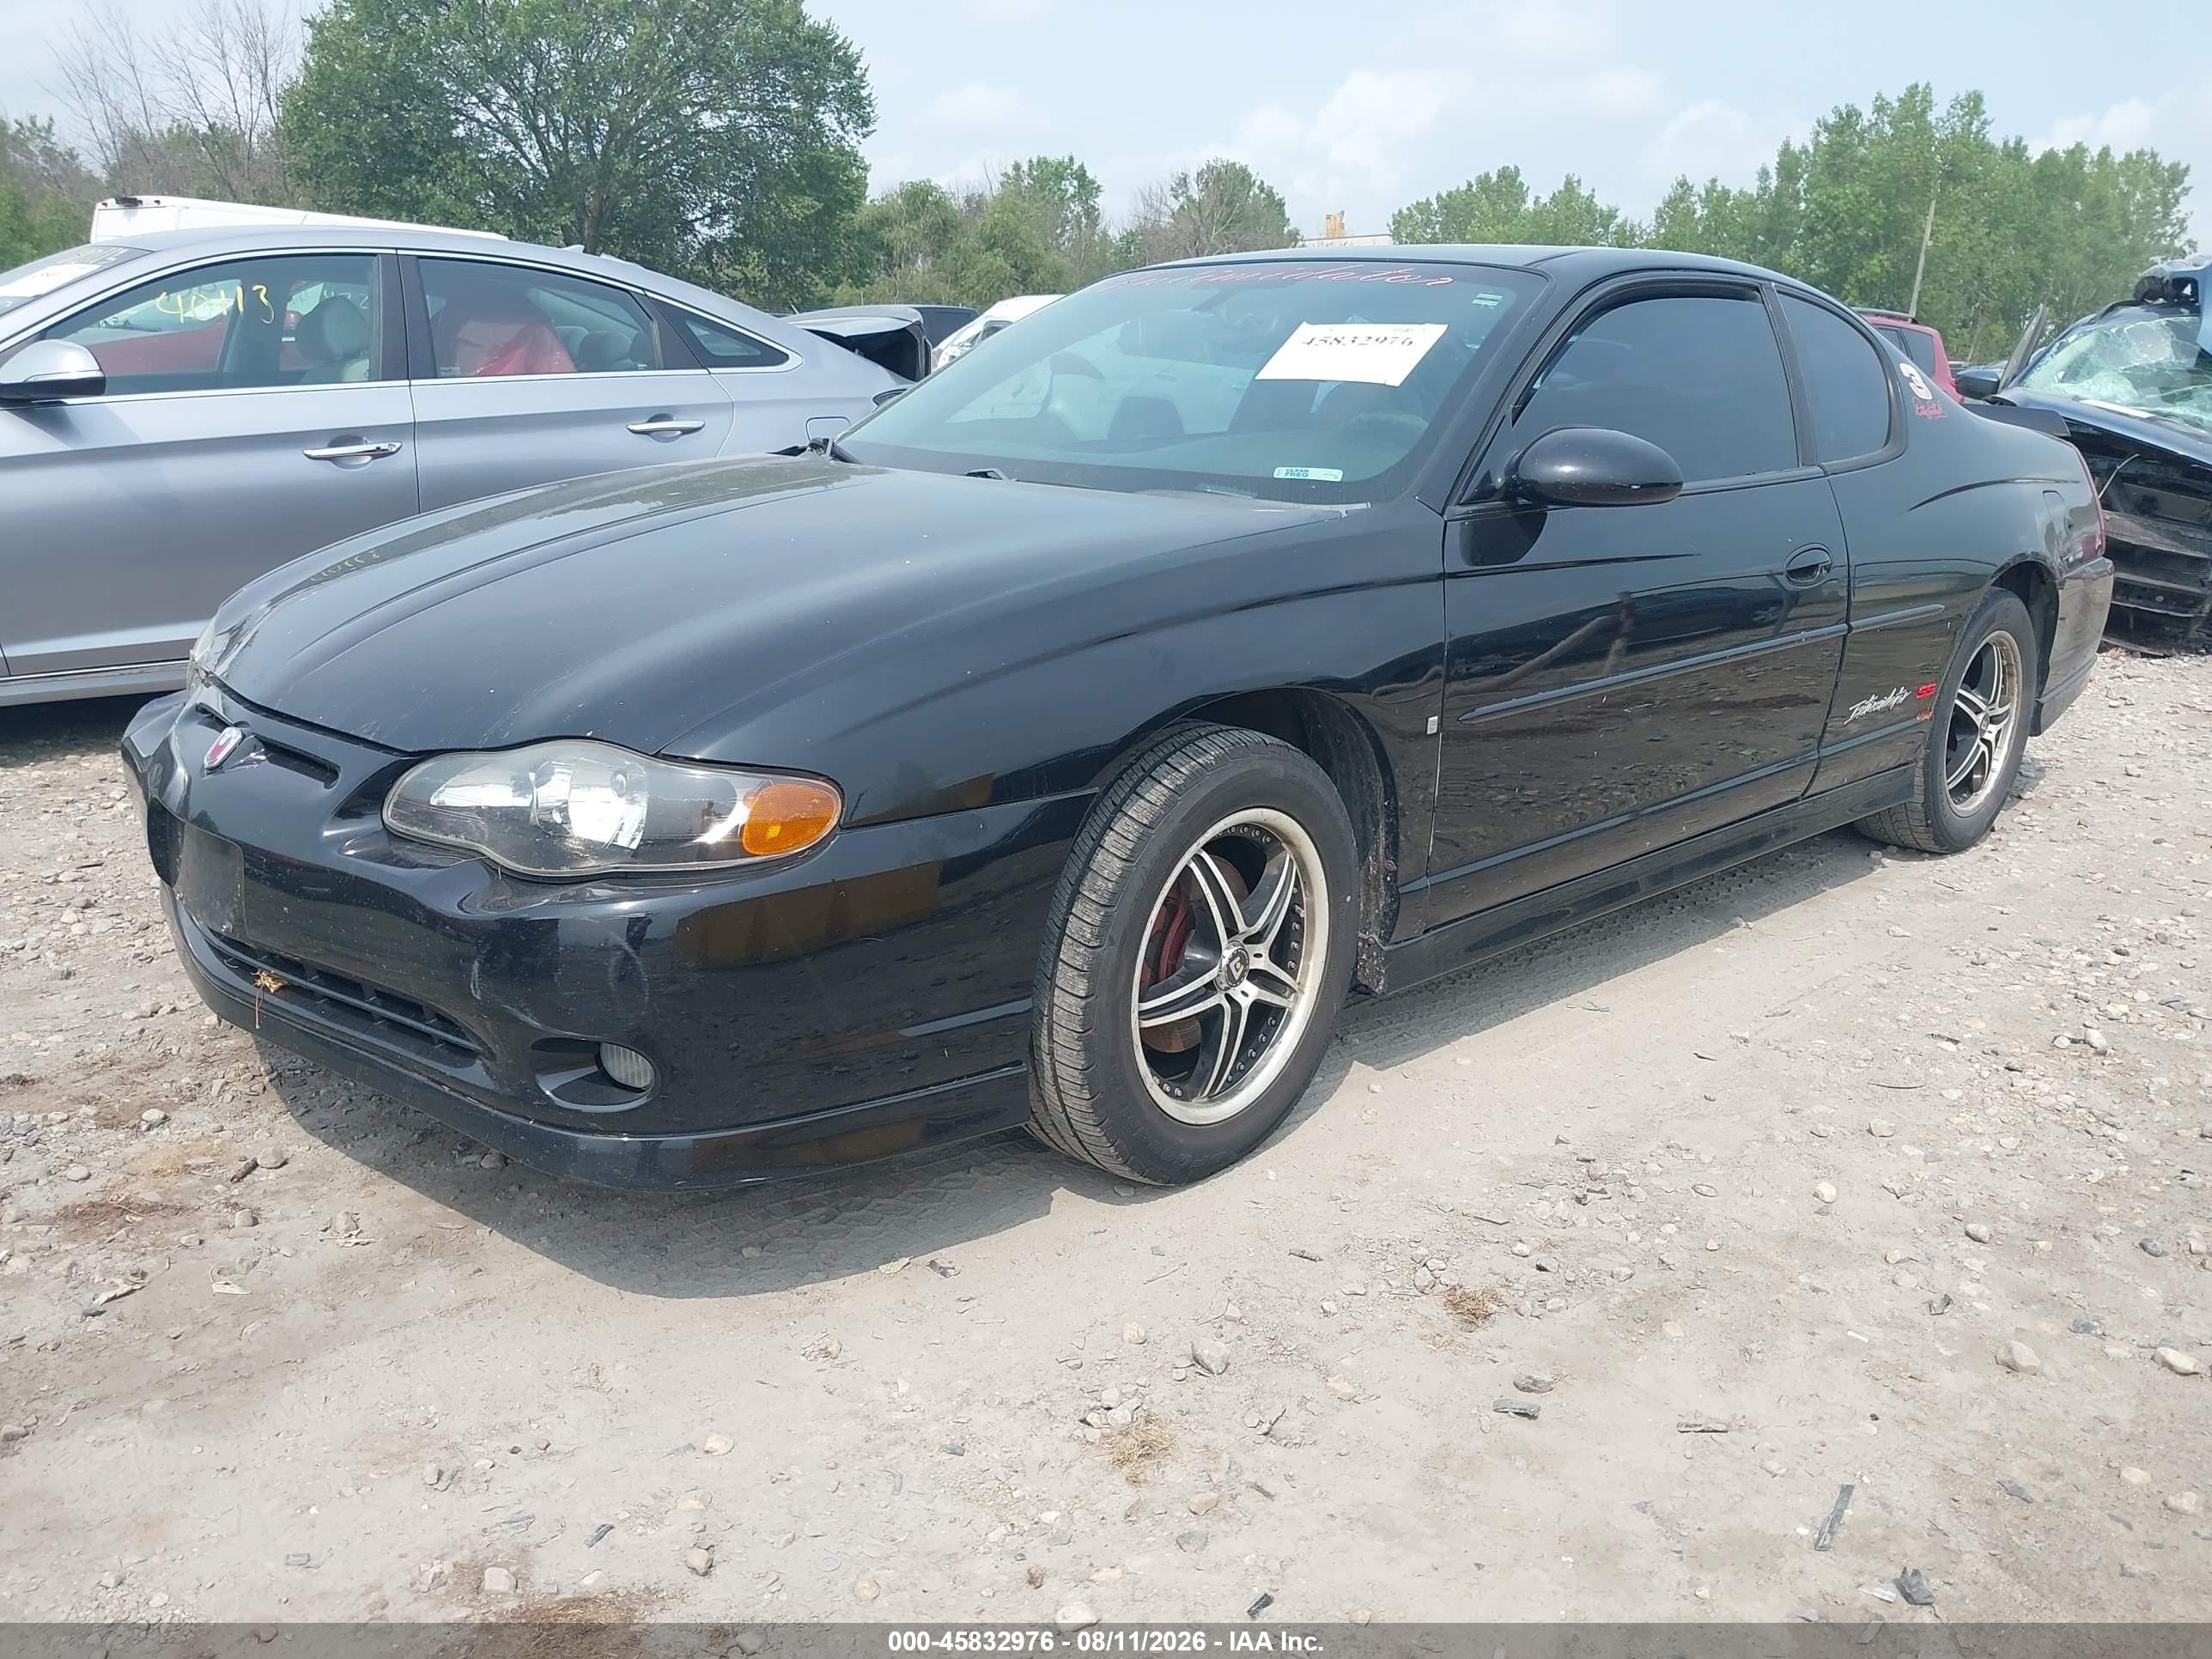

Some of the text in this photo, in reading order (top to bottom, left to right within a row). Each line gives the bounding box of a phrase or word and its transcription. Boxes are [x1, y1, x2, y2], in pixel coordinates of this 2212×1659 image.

[155, 284, 275, 324] 40113
[1302, 336, 1414, 347] 45832976
[1899, 362, 1933, 400] 3
